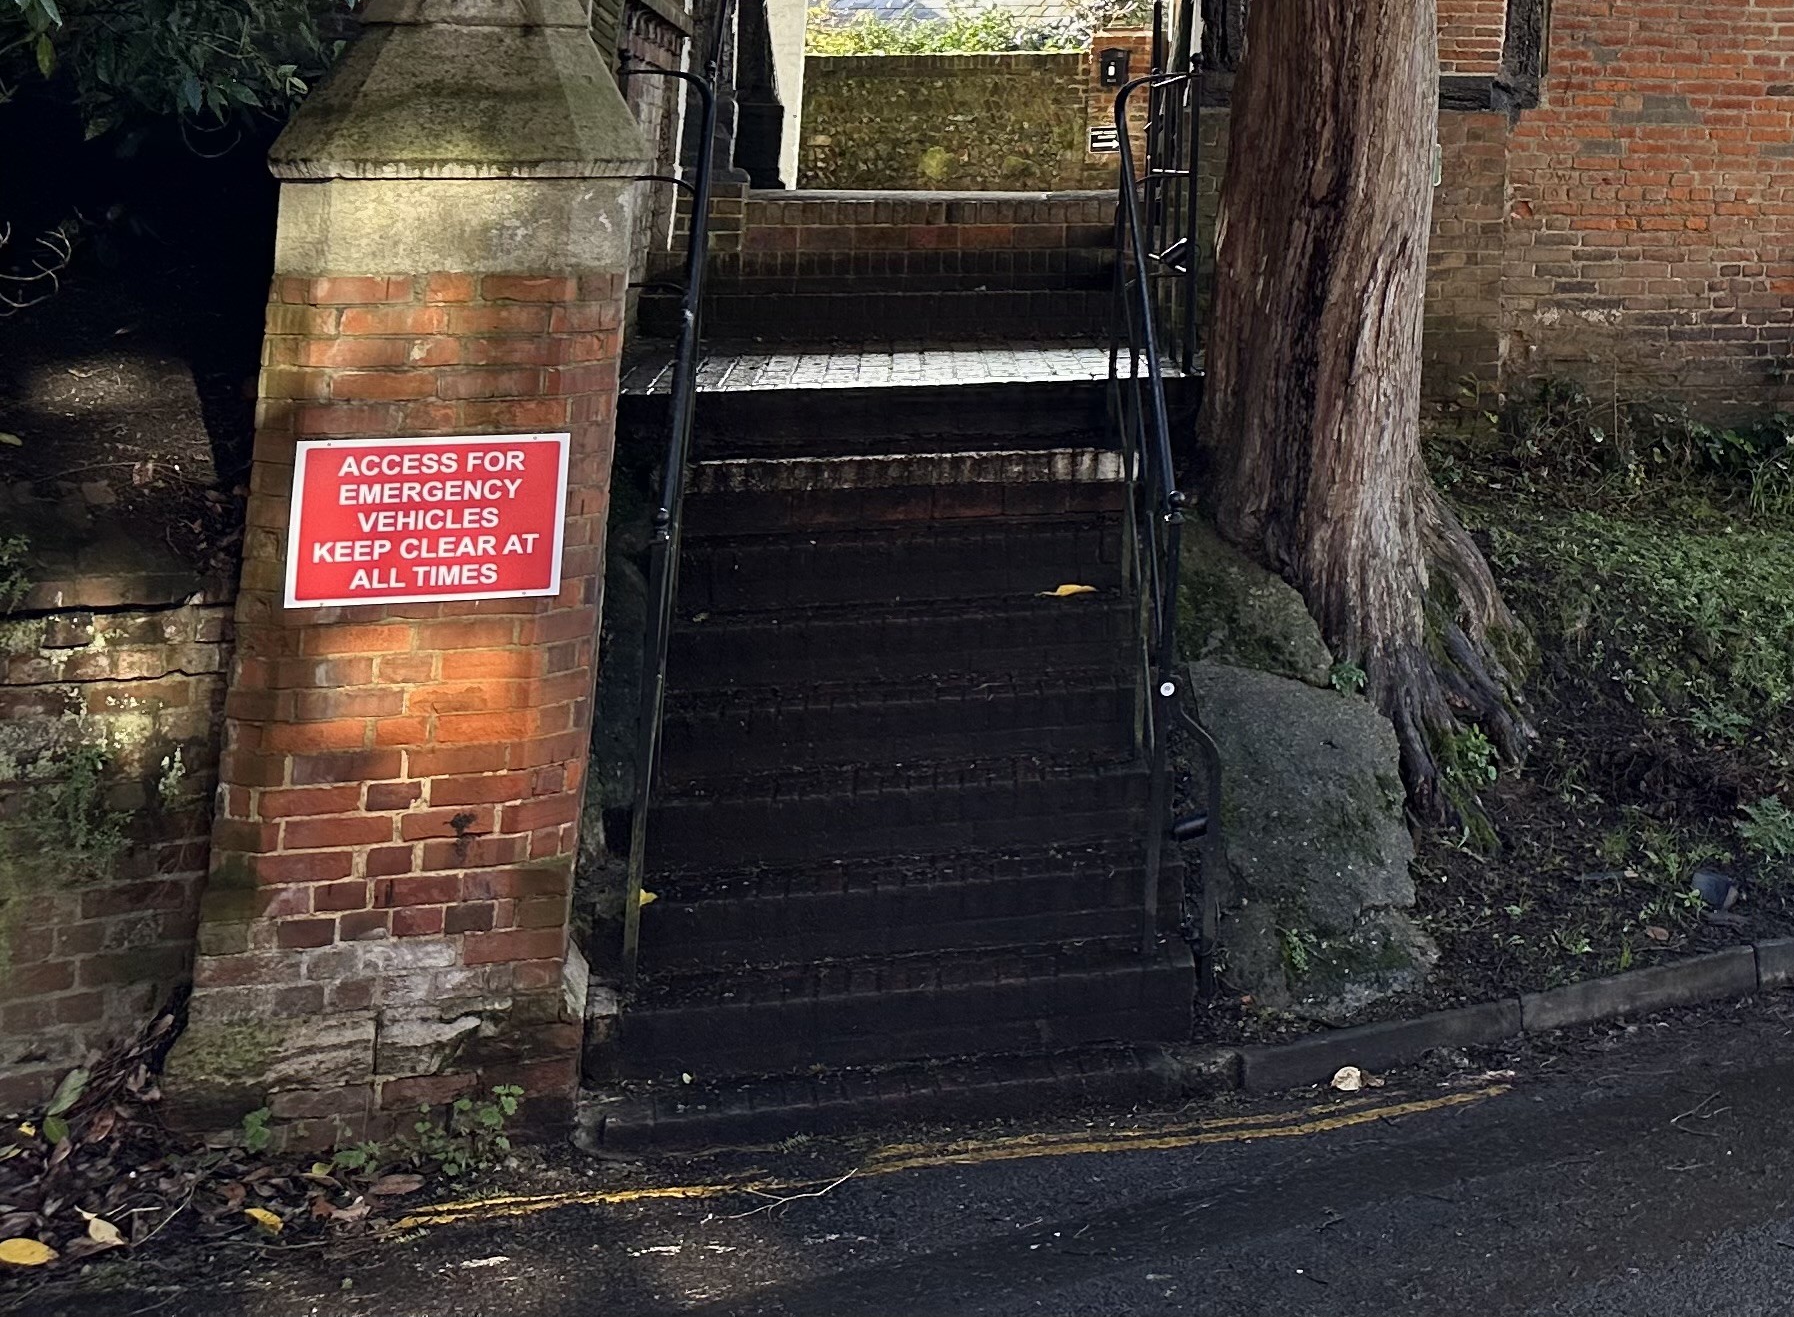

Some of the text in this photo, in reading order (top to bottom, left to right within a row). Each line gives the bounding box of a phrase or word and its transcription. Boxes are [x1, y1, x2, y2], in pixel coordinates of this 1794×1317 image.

[338, 450, 525, 477] ACCESS FOR
[338, 478, 523, 505] EMERGENCY
[357, 507, 499, 533] VEHICLES
[312, 533, 540, 563] KEEP CLEAR AT
[349, 563, 498, 590] ALL TIMES
